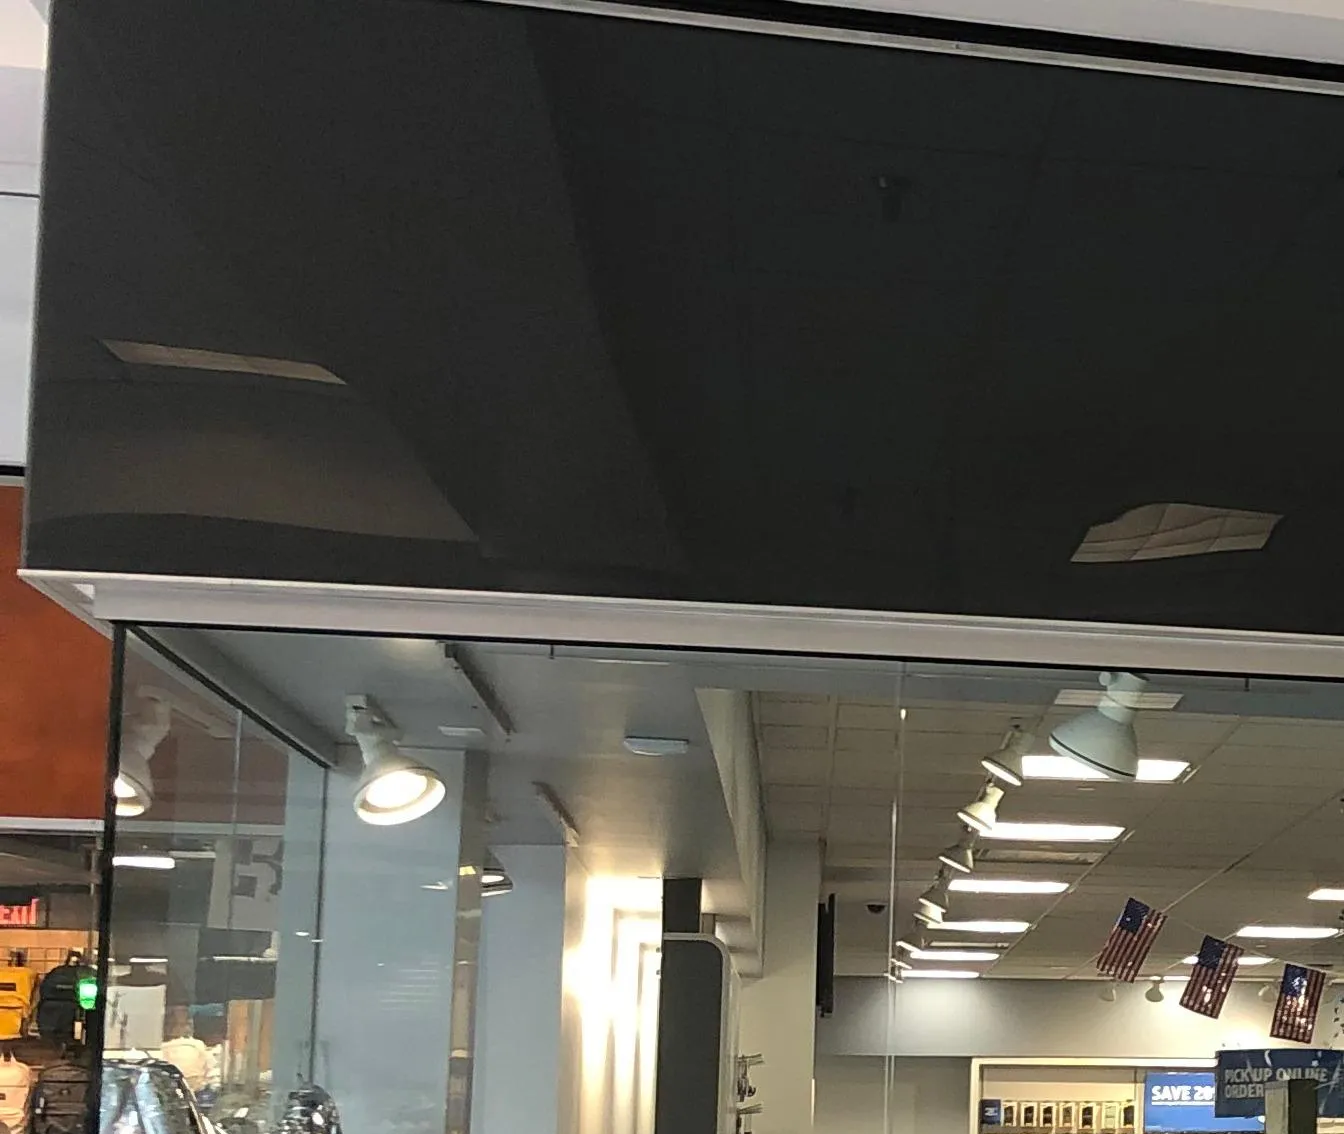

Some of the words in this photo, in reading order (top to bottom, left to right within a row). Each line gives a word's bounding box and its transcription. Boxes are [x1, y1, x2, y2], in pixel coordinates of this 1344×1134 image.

[1224, 1067, 1251, 1083] PICK
[1252, 1067, 1273, 1082] UP
[1275, 1067, 1329, 1083] ONLINE
[1151, 1085, 1192, 1101] SAVE
[1193, 1085, 1215, 1101] 20
[1224, 1084, 1265, 1099] ORDER
